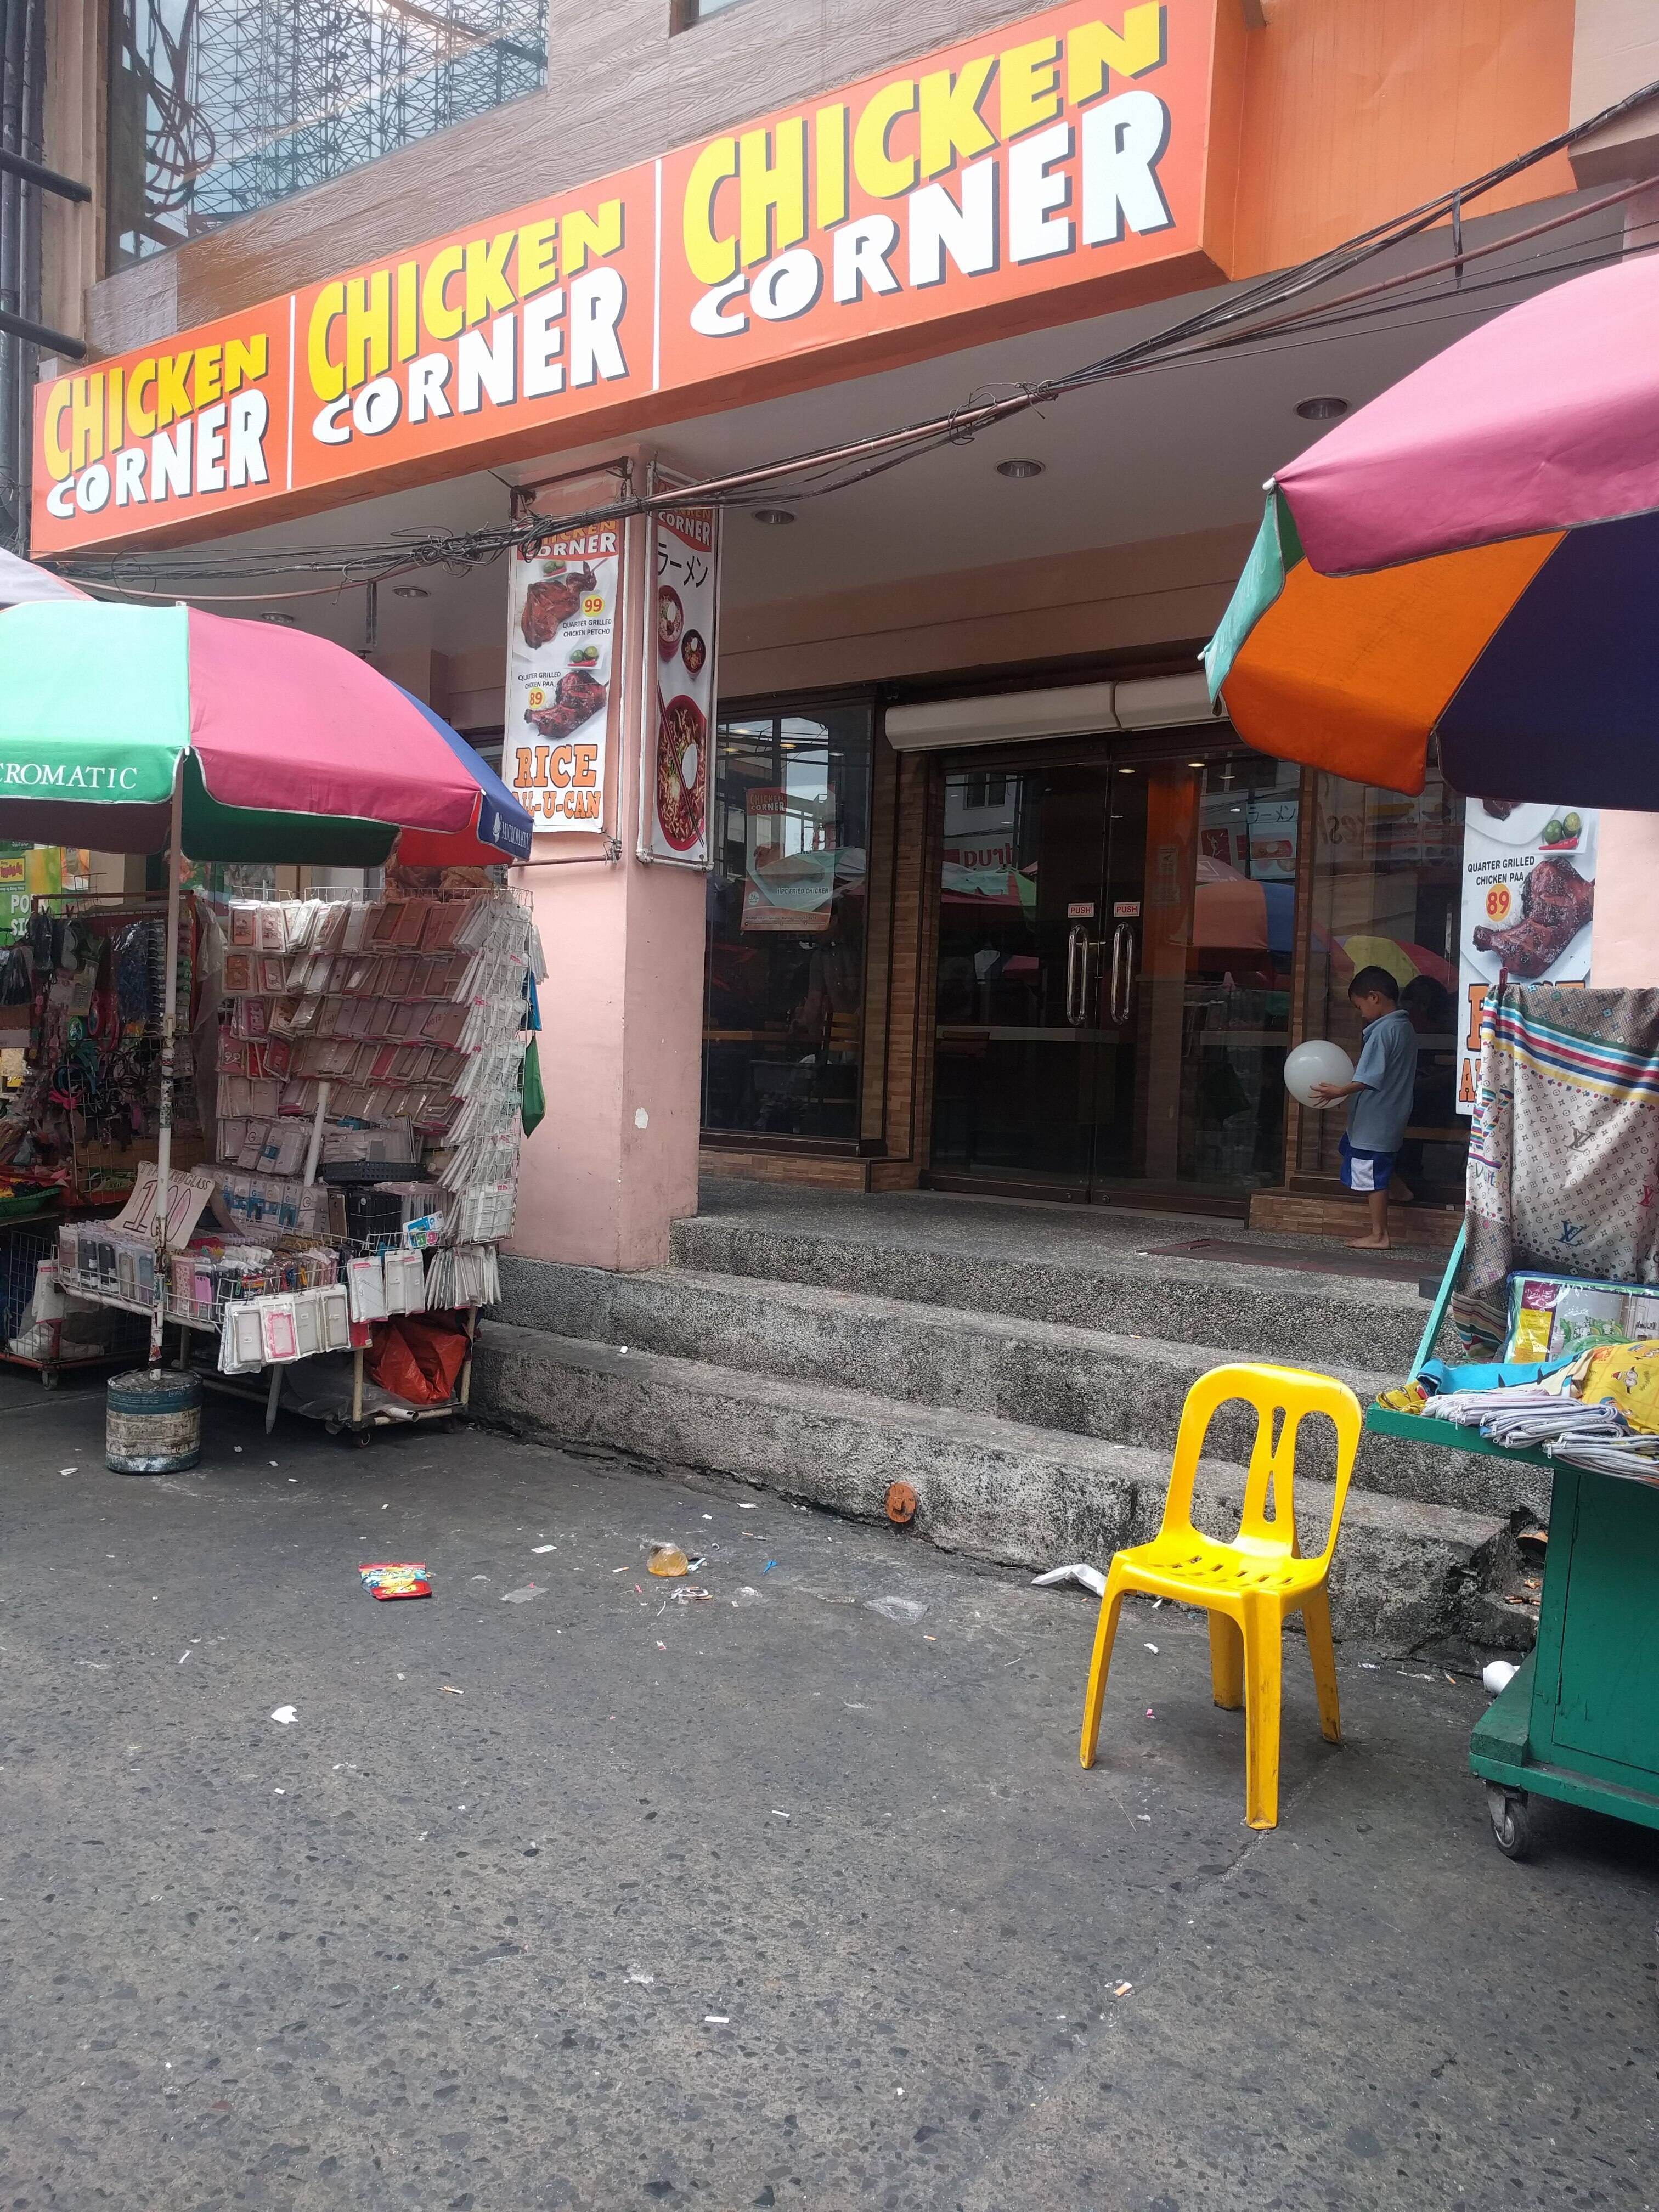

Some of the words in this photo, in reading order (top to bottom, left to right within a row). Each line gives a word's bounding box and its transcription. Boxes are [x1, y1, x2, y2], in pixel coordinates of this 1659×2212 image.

[683, 0, 1167, 285] CHICKEN
[690, 90, 1175, 338] CORNER
[308, 198, 625, 402] CHICKEN
[312, 267, 630, 445] CORNER
[44, 333, 268, 482] CHICKEN
[46, 388, 270, 518] CORNER
[658, 511, 710, 546] CORNER
[585, 598, 602, 613] 99
[562, 620, 587, 629] QUARTER
[529, 692, 543, 706] 89
[514, 744, 598, 788] RICE
[750, 794, 784, 806] CHICKEN
[751, 802, 786, 811] CORNER
[1468, 860, 1500, 873] QUARTER
[1502, 856, 1535, 868] GRILLED
[1476, 873, 1507, 885] CHICKEN
[1509, 872, 1524, 882] PAA
[1070, 906, 1091, 915] PUSH
[1116, 905, 1138, 913] PUSH
[1487, 890, 1510, 915] 89
